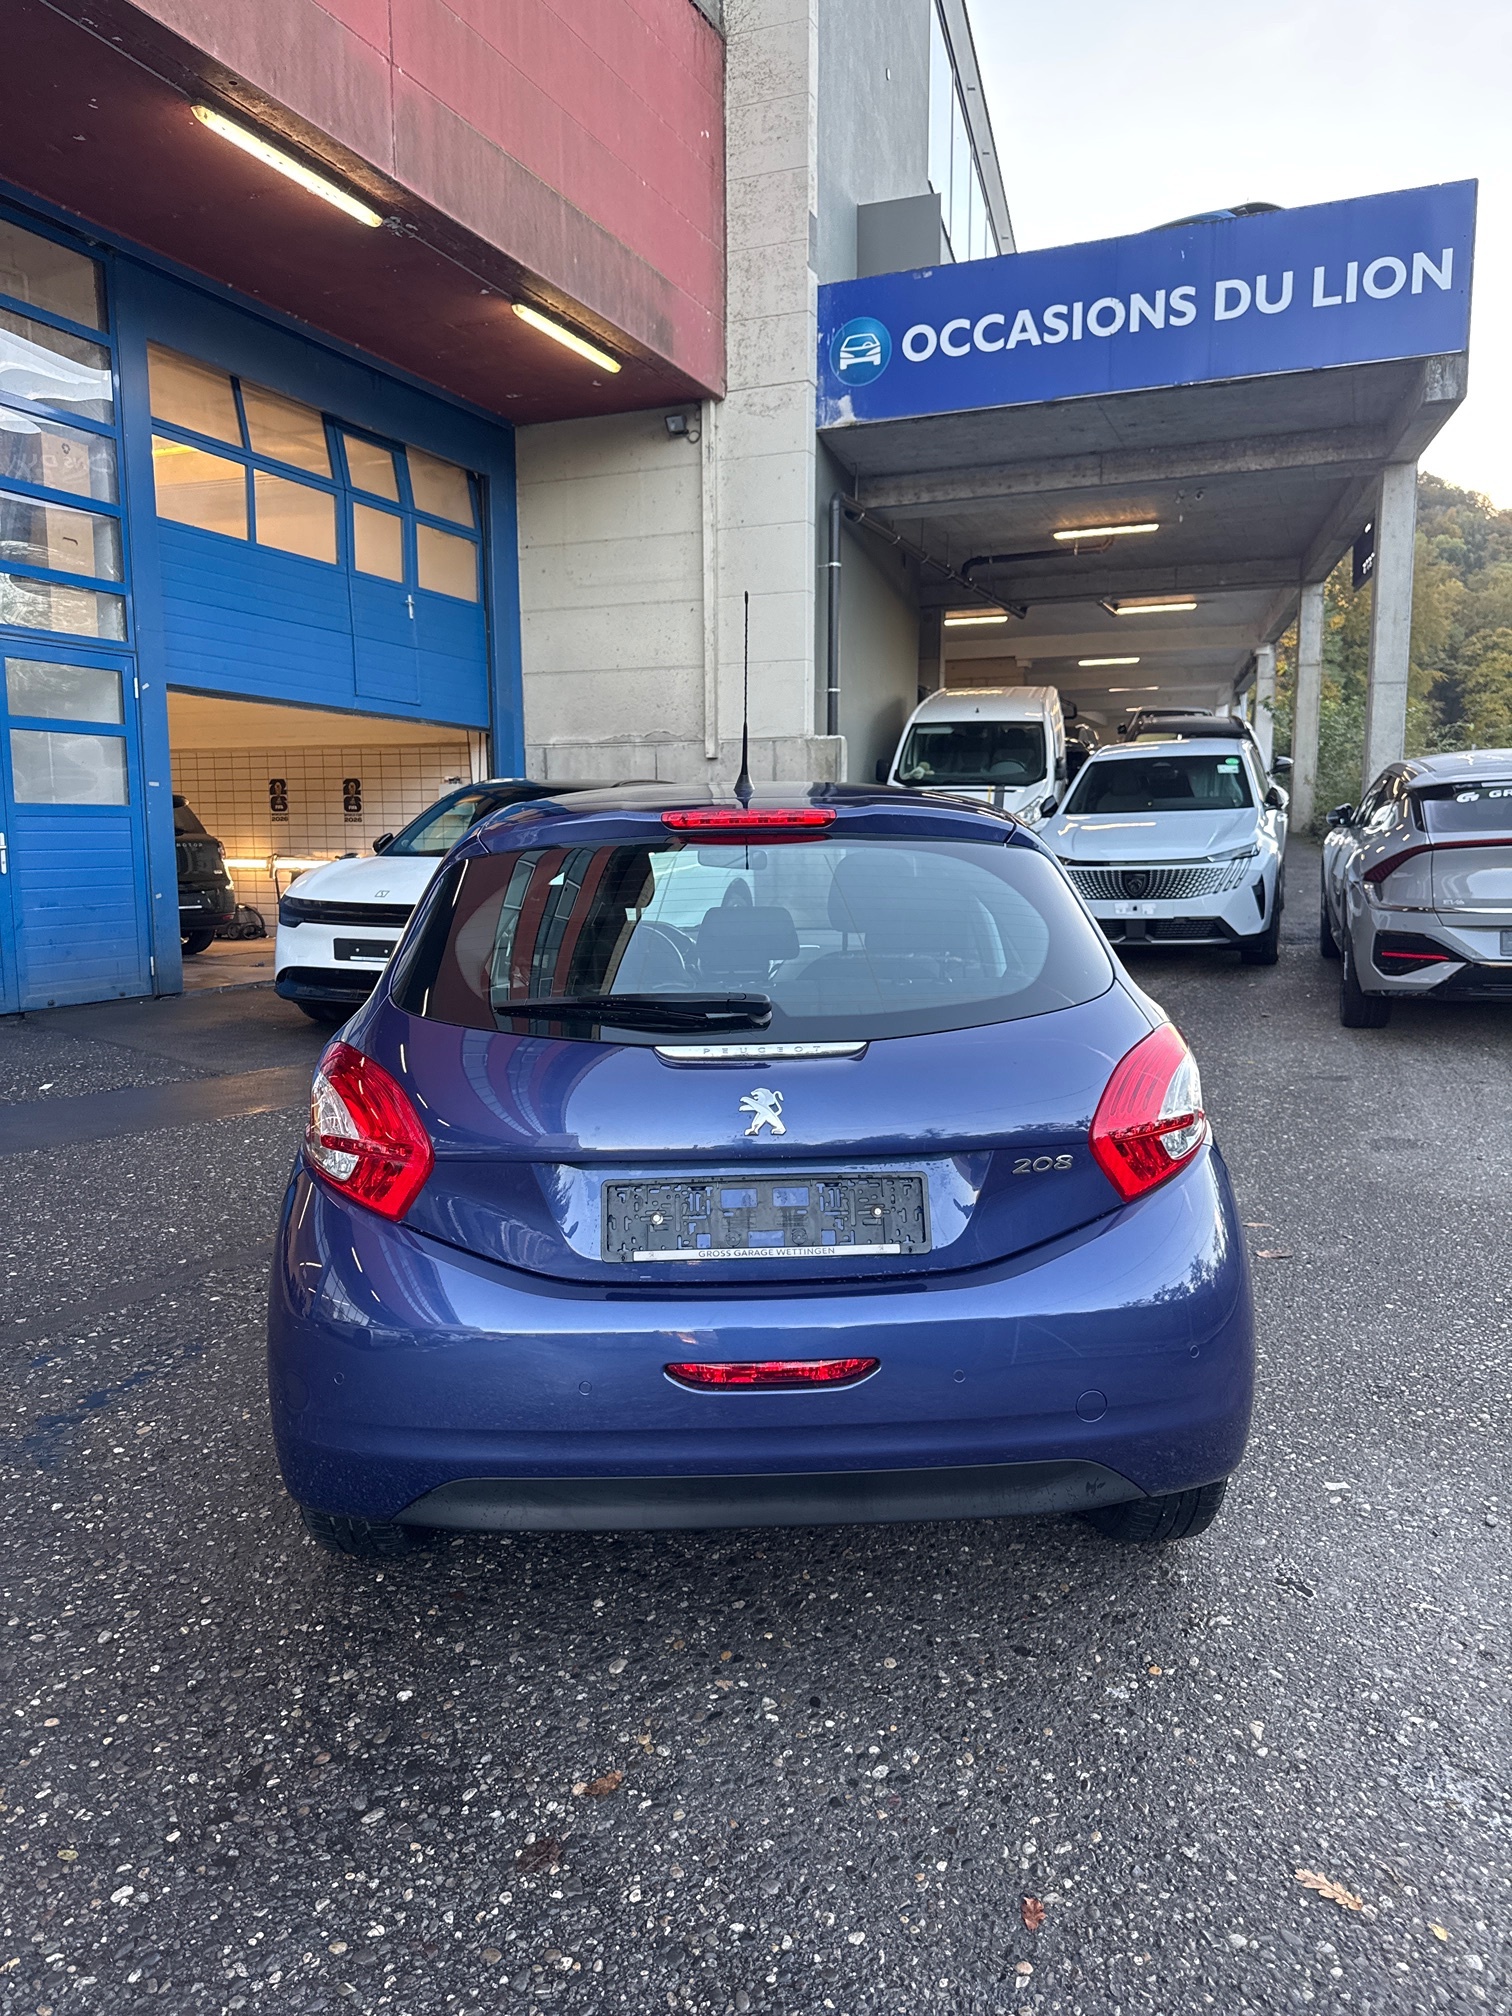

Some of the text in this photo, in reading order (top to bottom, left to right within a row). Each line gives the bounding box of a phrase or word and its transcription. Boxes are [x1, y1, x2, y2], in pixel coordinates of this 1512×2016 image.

[901, 247, 1454, 362] OCCASIONS DU LION
[703, 1045, 821, 1055] PEUGEOT
[1011, 1154, 1074, 1175] 208
[698, 1247, 835, 1258] GROSS GARAGE WETTINGEN
